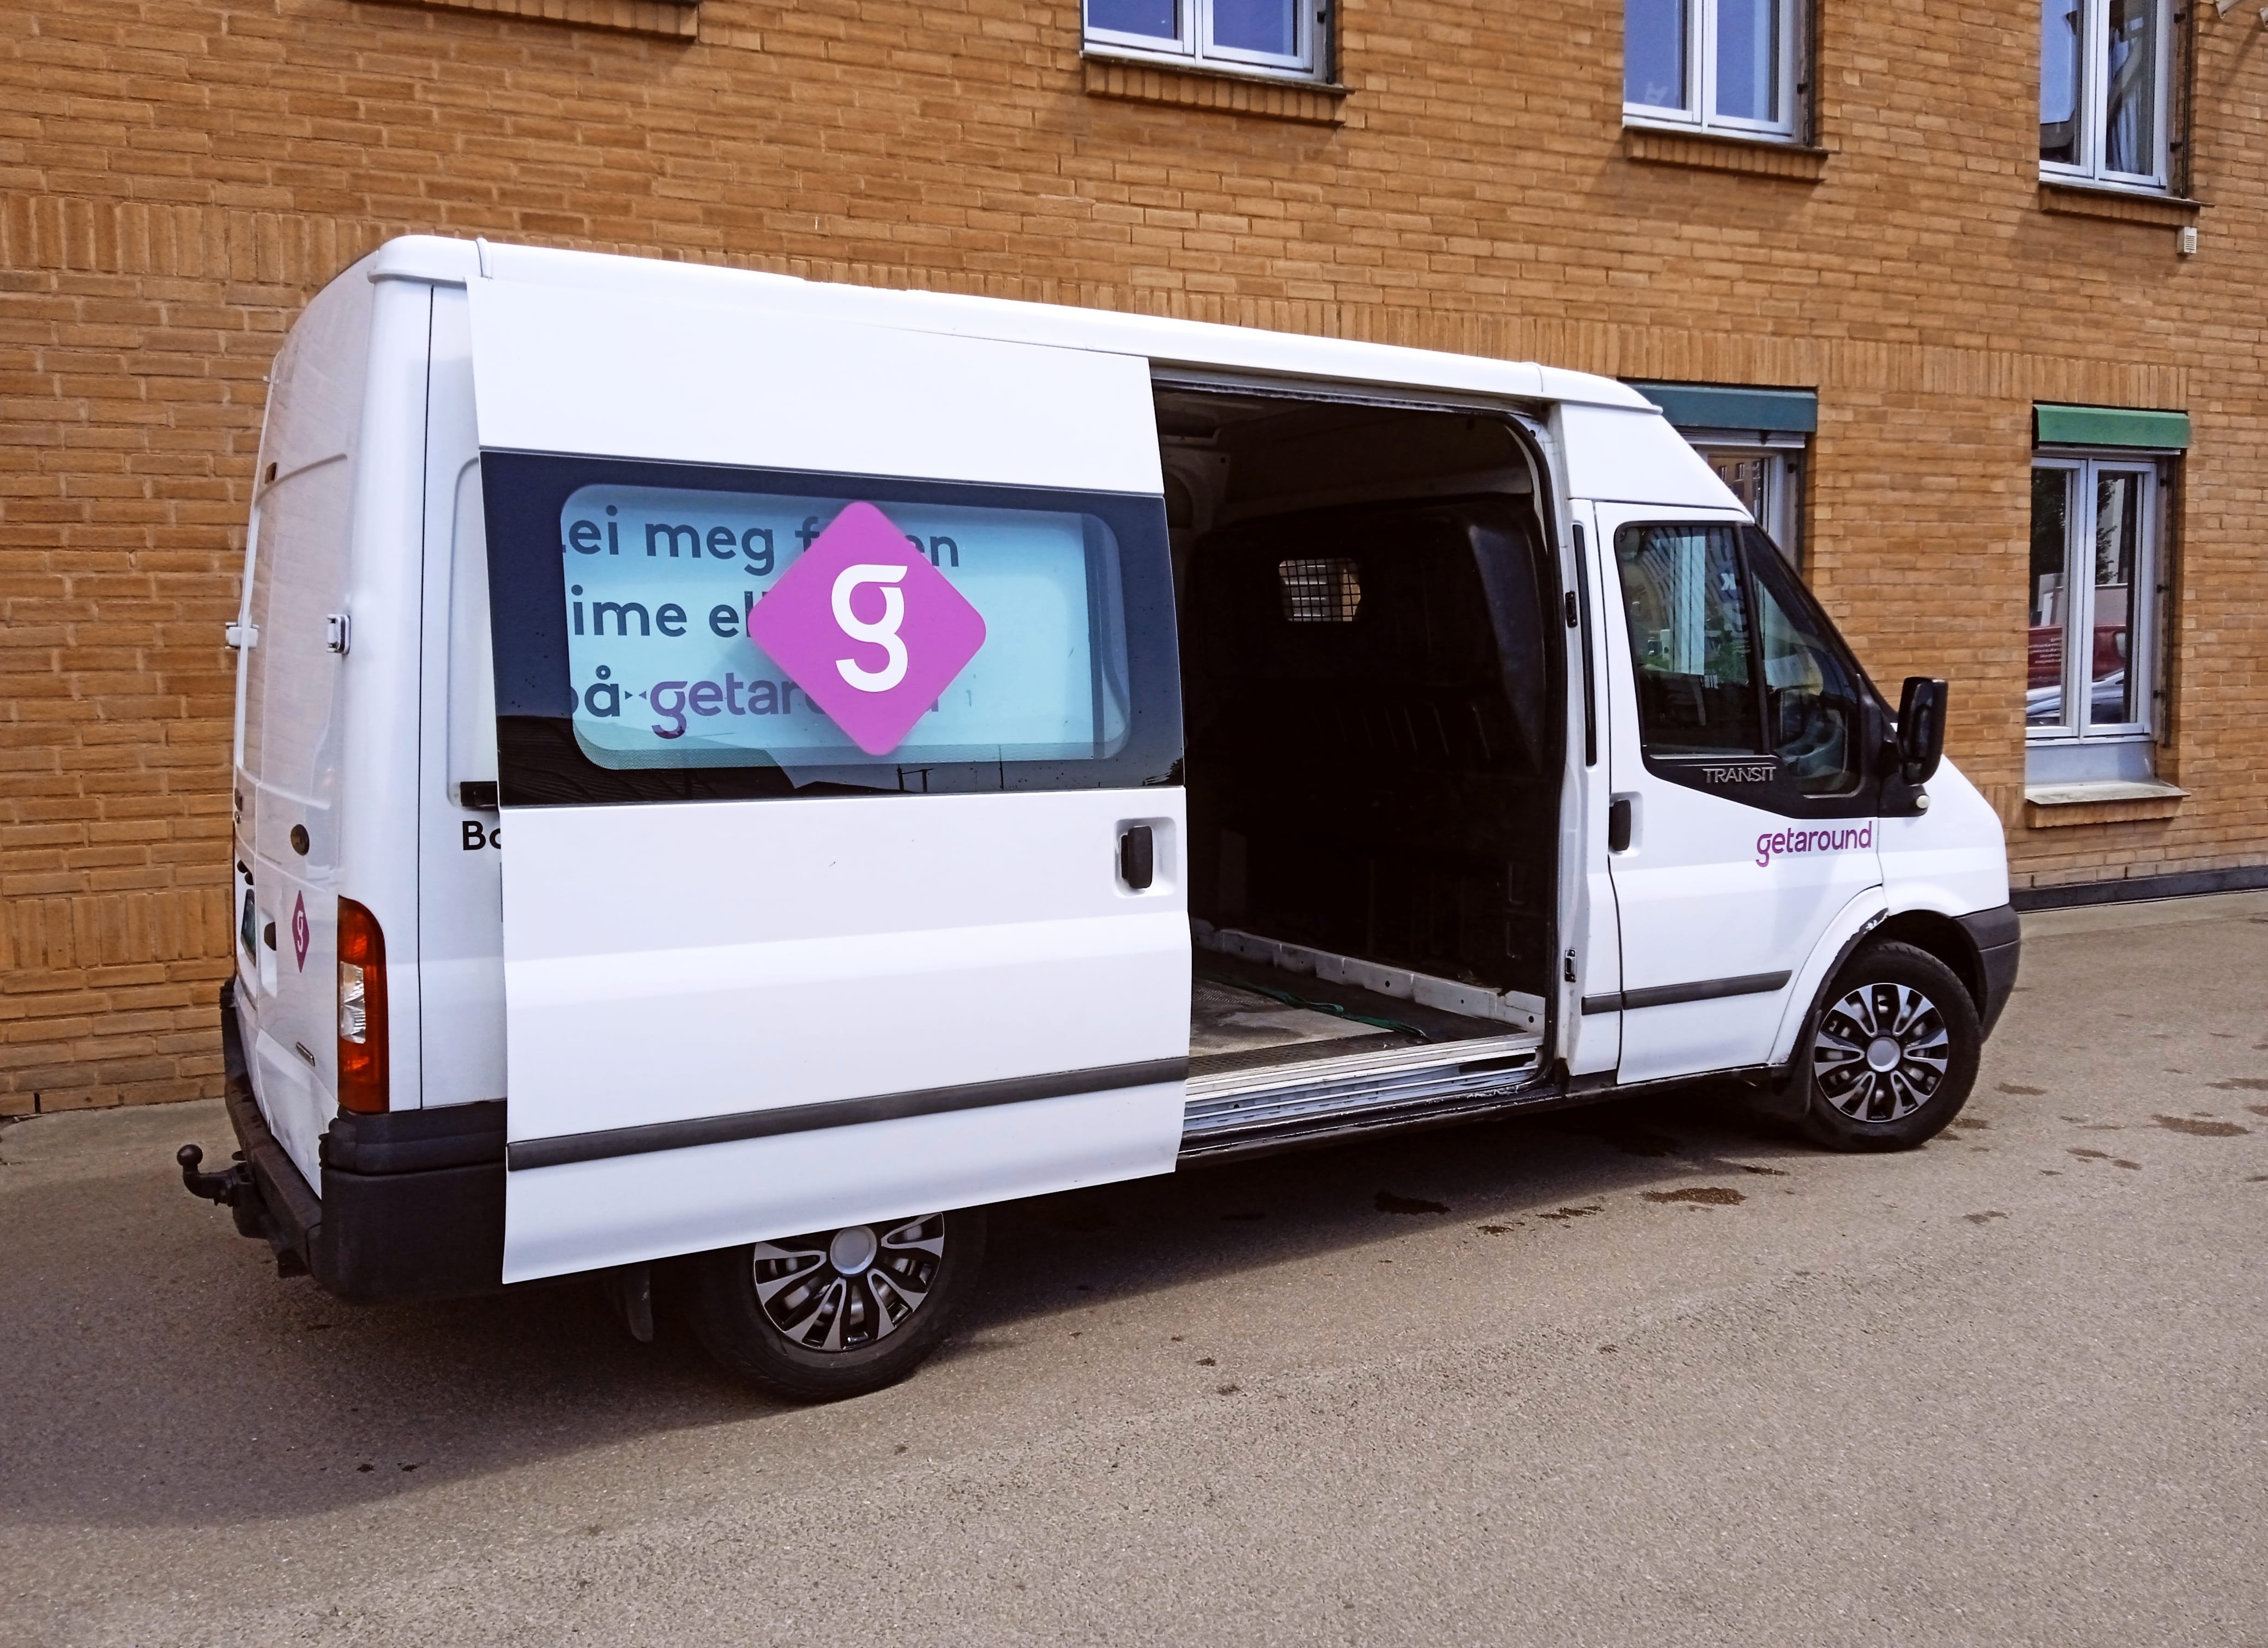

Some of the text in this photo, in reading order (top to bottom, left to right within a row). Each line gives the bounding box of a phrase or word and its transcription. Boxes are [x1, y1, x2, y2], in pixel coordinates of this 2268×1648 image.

[562, 504, 619, 556] ei
[644, 522, 775, 576] meg
[708, 590, 768, 638] el
[831, 564, 908, 693] g
[570, 665, 620, 717] å
[1702, 766, 1776, 783] TRANSIT
[1756, 820, 1872, 867] getaround
